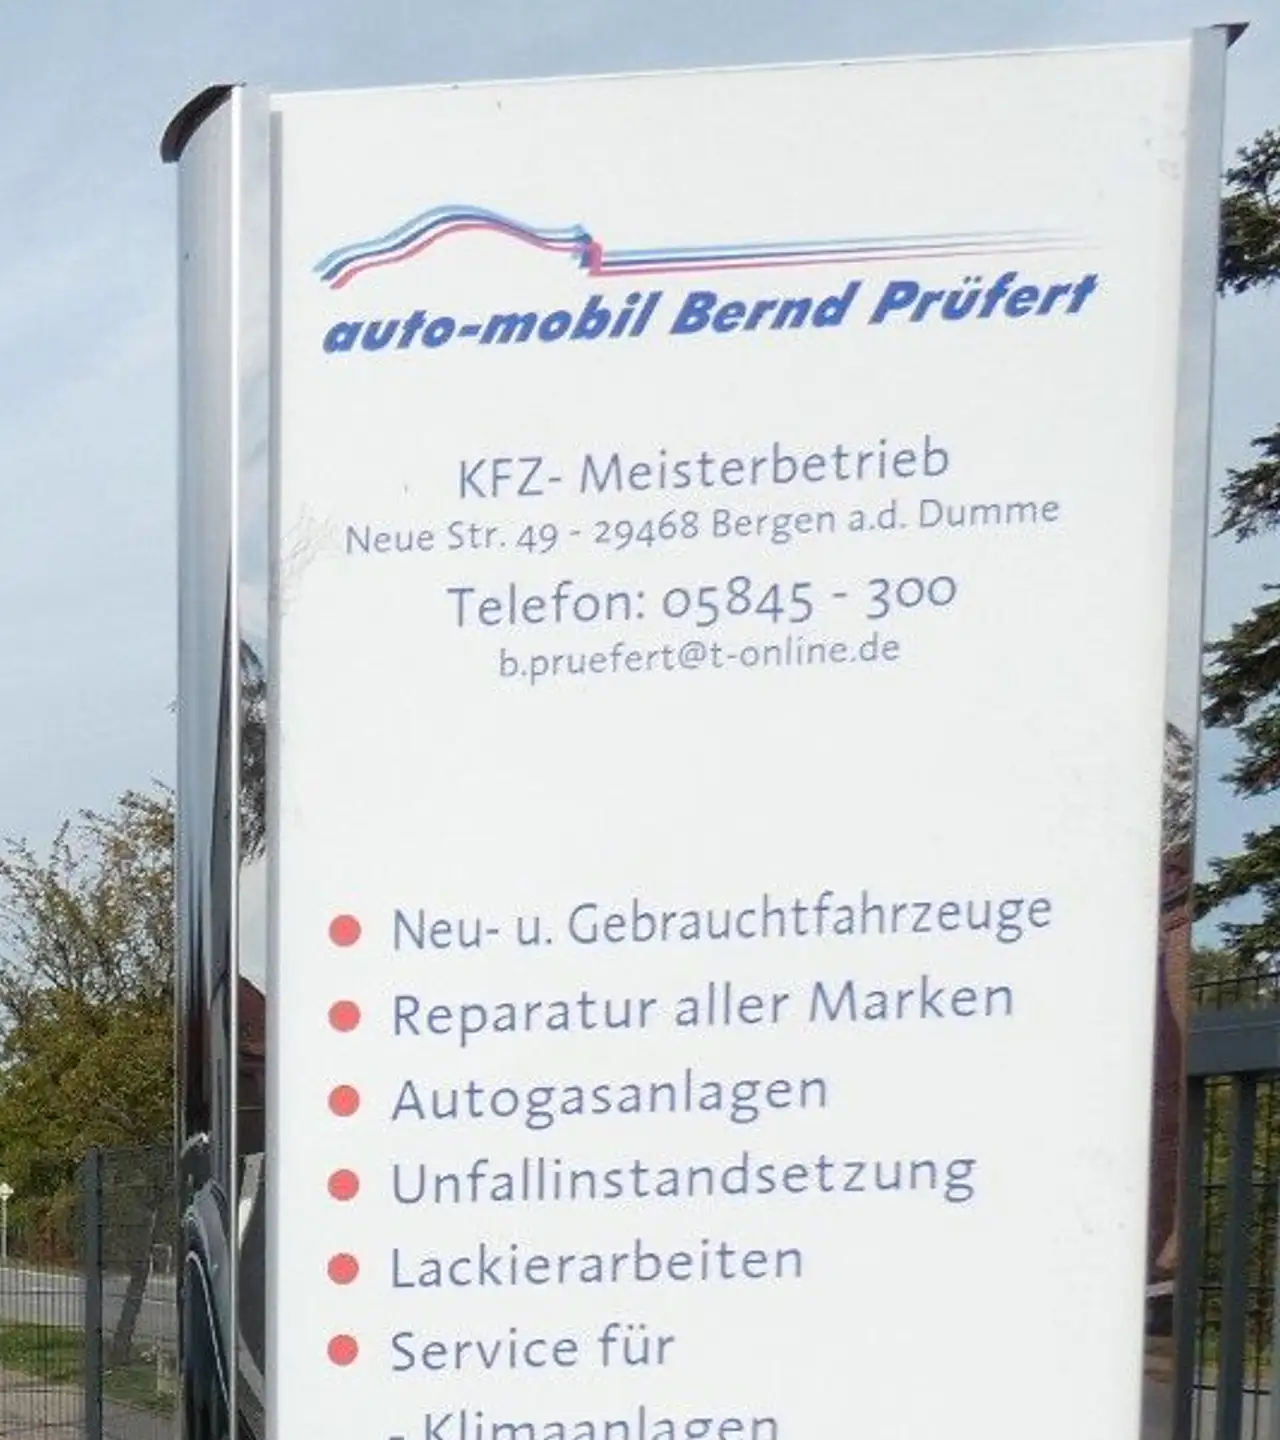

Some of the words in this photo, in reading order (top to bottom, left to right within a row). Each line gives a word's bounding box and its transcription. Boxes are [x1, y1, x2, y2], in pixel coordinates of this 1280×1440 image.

[322, 289, 665, 355] auto-mobil
[667, 279, 864, 336] Bernd
[866, 270, 1100, 331] Prüfert
[459, 455, 563, 500] KFZ-
[579, 433, 950, 495] Meisterbetrieb
[346, 525, 435, 555] Neue
[447, 520, 506, 551] Str.
[515, 524, 559, 565] 49
[594, 508, 699, 551] 29468
[712, 508, 836, 545] Bergen
[847, 498, 908, 533] a.d.
[919, 498, 1060, 530] Dumme
[446, 579, 645, 629] Telefon:
[662, 575, 814, 629] 05845
[865, 575, 958, 621] 300
[499, 630, 901, 688] b.pruefert@t-online.de
[393, 907, 500, 952] Neu-
[516, 916, 553, 947] u.
[568, 889, 1053, 947] Gebrauchtfahrzeuge
[393, 990, 658, 1049] Reparatur
[674, 980, 790, 1027] aller
[808, 973, 1013, 1023] Marken
[390, 1067, 828, 1131] Autogasanlagen
[393, 1149, 977, 1205] Unfallinstandsetzung
[391, 1237, 802, 1289] Lackierarbeiten
[391, 1330, 579, 1373] Service
[597, 1321, 676, 1368] für
